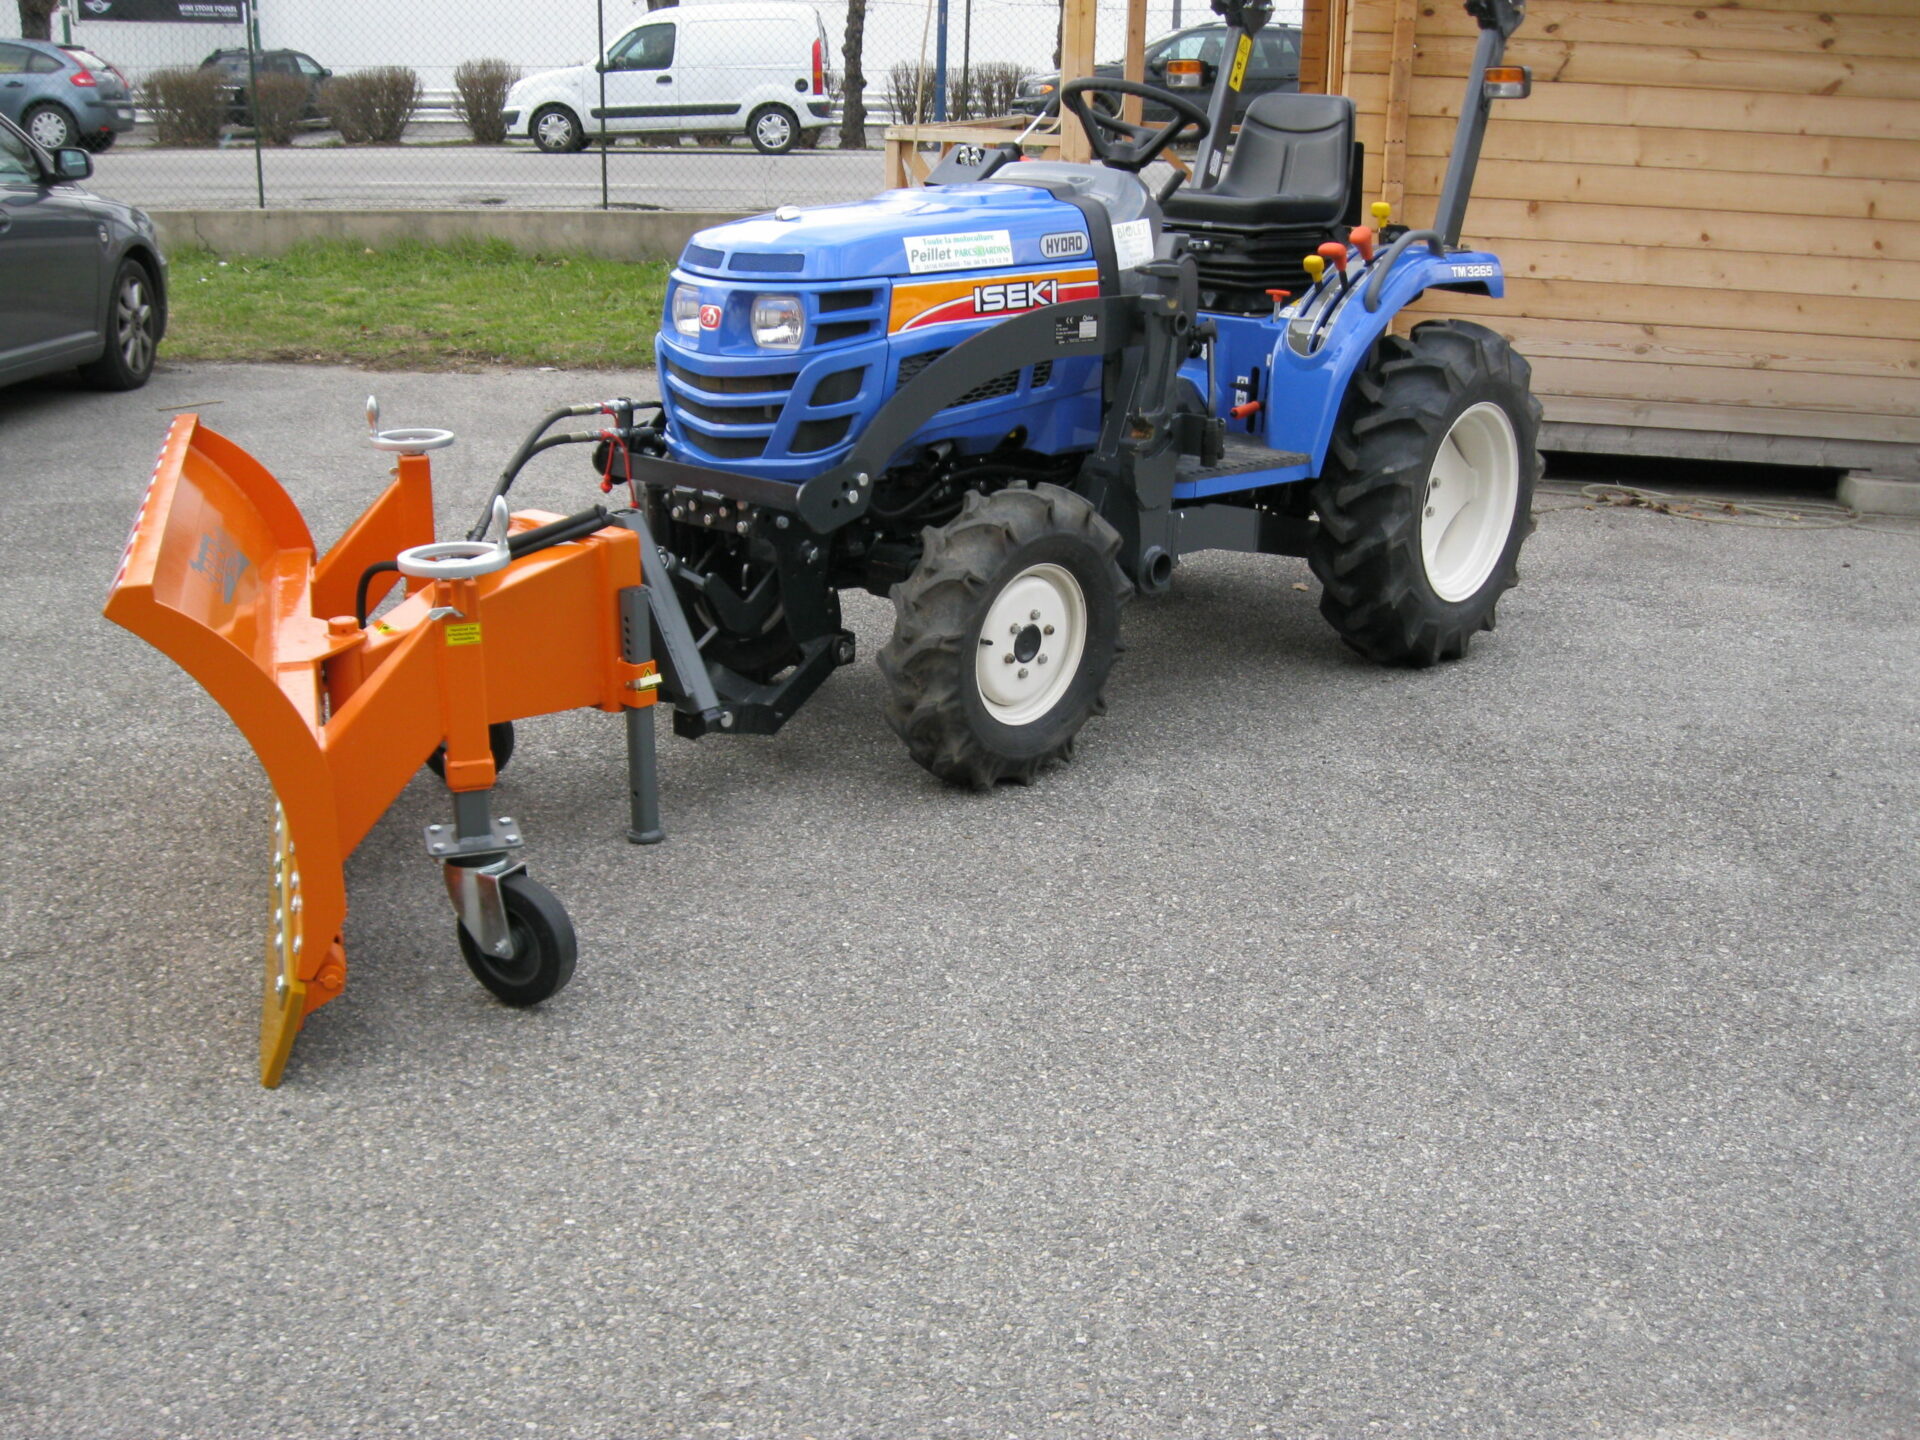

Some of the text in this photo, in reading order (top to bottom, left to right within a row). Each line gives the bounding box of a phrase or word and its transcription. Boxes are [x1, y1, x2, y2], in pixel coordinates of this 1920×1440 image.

[922, 233, 994, 246] Toute la motoculture
[1046, 235, 1083, 255] HYDRO
[911, 247, 952, 263] Peillet
[1451, 264, 1493, 278] TM 3265
[974, 279, 1058, 313] ISEKI
